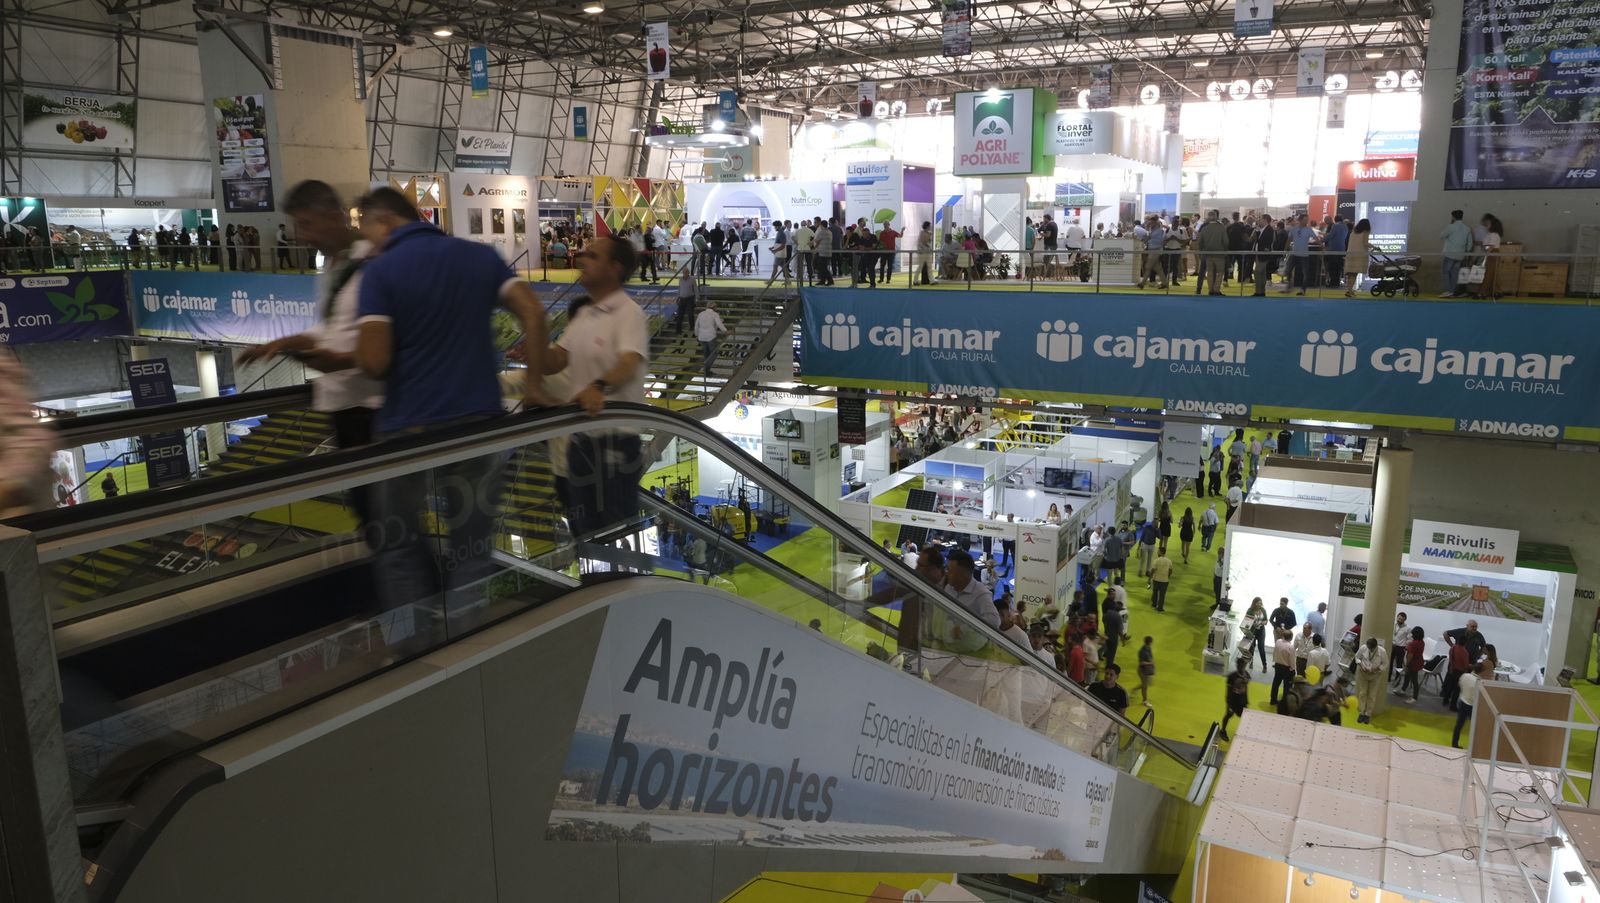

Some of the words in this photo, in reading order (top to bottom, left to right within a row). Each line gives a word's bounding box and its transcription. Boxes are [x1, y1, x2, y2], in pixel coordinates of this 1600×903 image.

[1474, 12, 1488, 22] de
[1489, 13, 1506, 21] sus
[1508, 10, 1540, 20] minas
[1542, 9, 1551, 18] y
[1552, 7, 1566, 16] los
[1497, 22, 1537, 33] abonos
[1538, 20, 1554, 30] de
[1554, 18, 1574, 28] alta
[1506, 36, 1530, 46] para
[1532, 34, 1547, 43] las
[1548, 32, 1588, 44] plantas
[975, 138, 1007, 152] AGRI
[960, 152, 1020, 166] POLYANE
[848, 164, 888, 176] Liquifert
[1566, 168, 1598, 178] K+S
[478, 187, 527, 196] AGRIMOR
[808, 196, 822, 206] Crop
[162, 290, 218, 315] cajamar
[254, 294, 316, 318] cajamar
[868, 318, 1000, 356] cajamar
[1093, 326, 1256, 368] cajamar
[930, 351, 958, 361] CAJA
[961, 352, 997, 363] RURAL
[1370, 338, 1575, 384] cajamar
[130, 362, 166, 376] SER
[1170, 362, 1202, 374] CAJA
[1206, 364, 1250, 376] RURAL
[938, 384, 996, 396] ADNAGRO
[1464, 378, 1505, 392] CAJA
[1511, 382, 1564, 395] RURAL
[1175, 400, 1248, 415] ADNAGRO
[1469, 420, 1559, 438] ADNAGRO
[1446, 534, 1496, 550] Rivulis
[1422, 546, 1504, 564] NAANDANJAIN
[1416, 586, 1461, 598] INNOVACIÓN
[623, 617, 797, 730] Amplía
[860, 701, 944, 758] Especialistas
[946, 738, 960, 761] en
[961, 733, 970, 766] la
[971, 737, 1025, 780] financiación
[1024, 764, 1030, 781] a
[1031, 764, 1057, 790] medida
[1057, 768, 1066, 792] de
[596, 713, 838, 823] horizontes
[851, 745, 933, 791] transmisión
[930, 773, 942, 800] y
[942, 774, 1003, 806] reconversión
[1004, 785, 1014, 808] de
[1015, 784, 1036, 813] fincas
[1036, 791, 1061, 818] rústicas
[1086, 776, 1108, 805] cajasur
